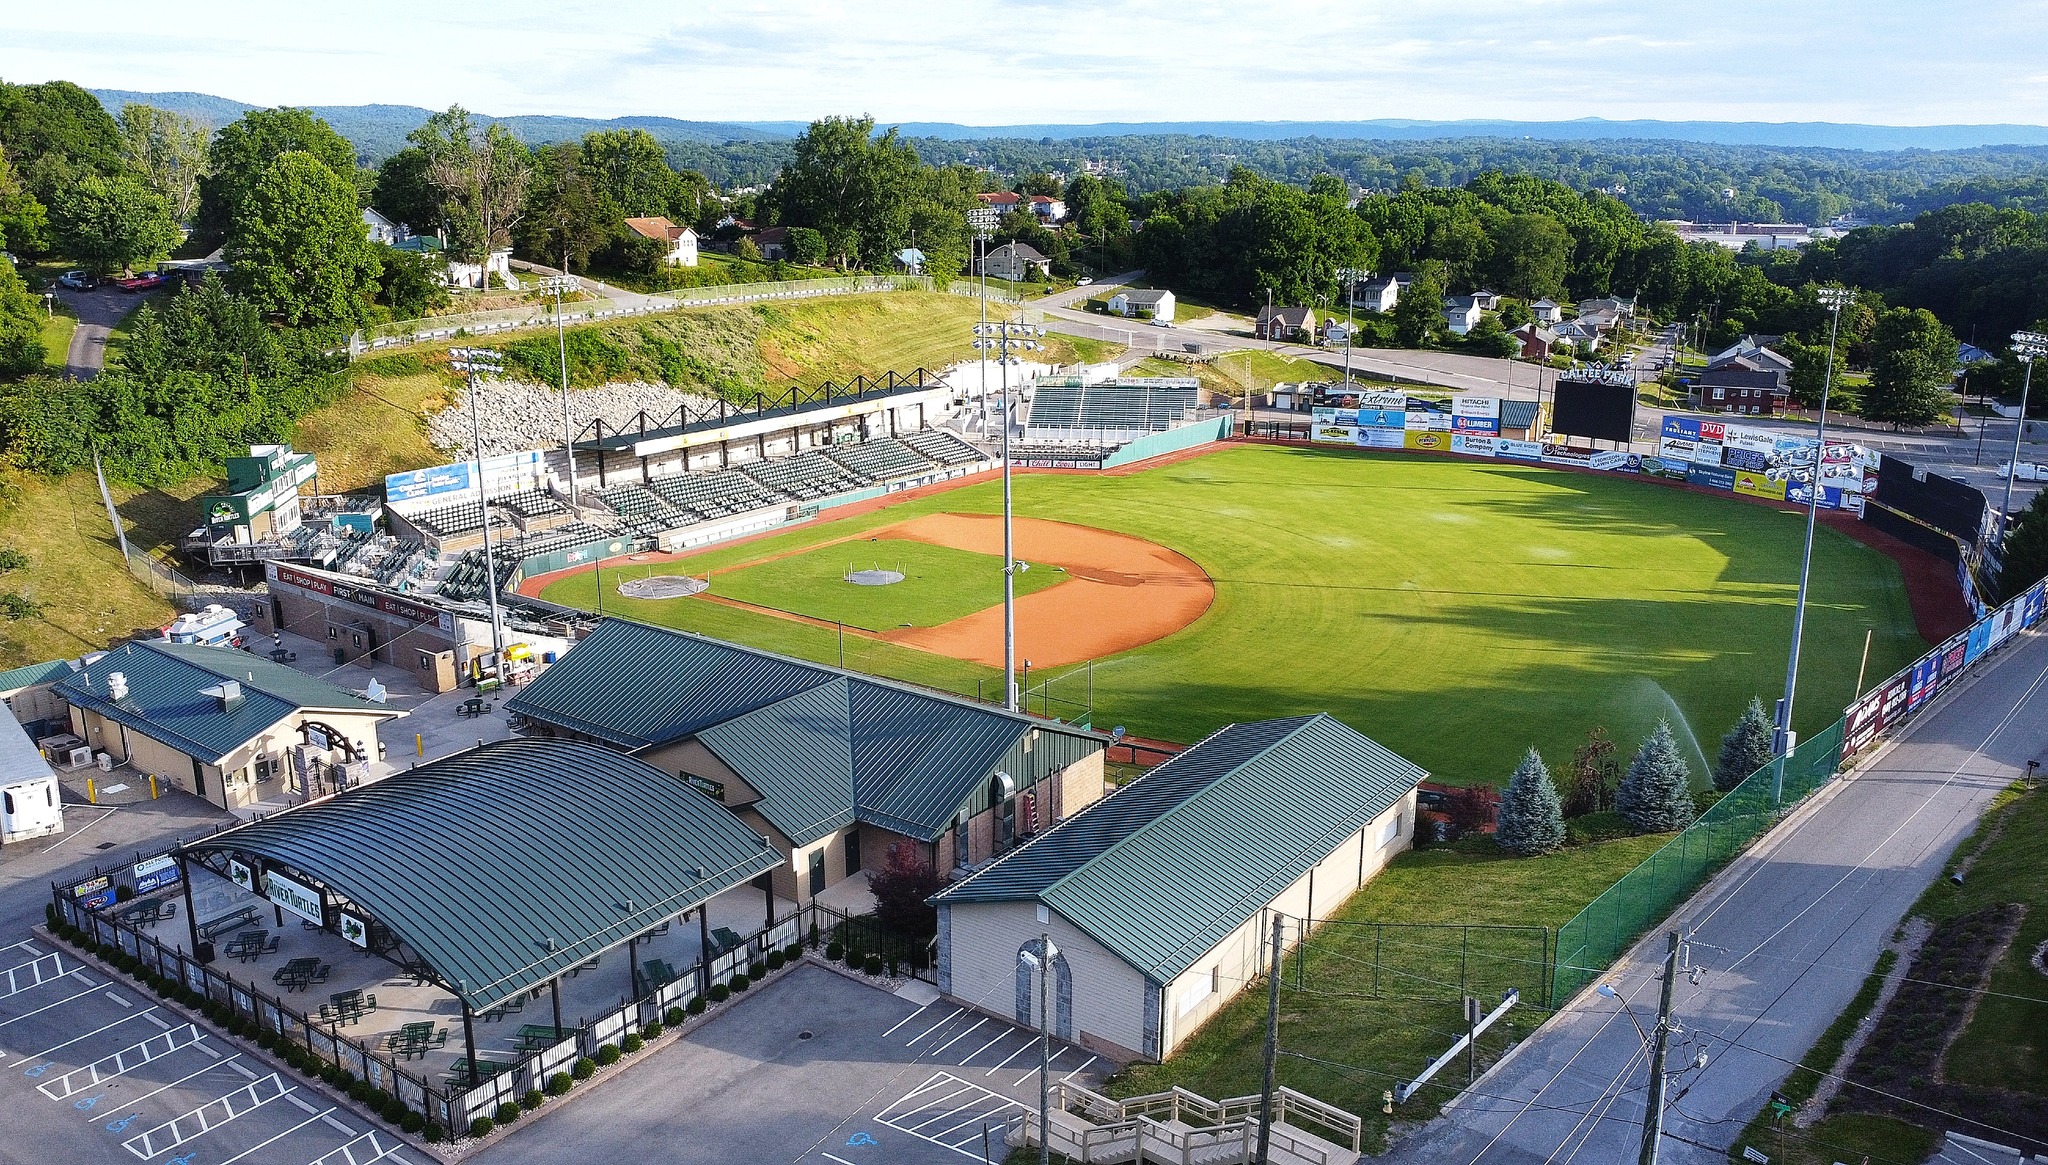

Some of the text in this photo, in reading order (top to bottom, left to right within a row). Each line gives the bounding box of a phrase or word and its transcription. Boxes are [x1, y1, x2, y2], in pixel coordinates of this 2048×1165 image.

[1561, 368, 1634, 387] CALFEE PARK
[1468, 420, 1492, 428] LUMBER
[1701, 423, 1723, 434] DVD
[1465, 436, 1486, 444] Burton
[1740, 432, 1773, 444] LewisGale
[1465, 443, 1493, 452] Company
[1554, 451, 1590, 459] Technologies
[1031, 459, 1049, 467] Chill
[432, 493, 468, 505] GENERAL
[283, 572, 327, 591] EAT SHOP PLAY
[333, 586, 375, 605] FIRST MAIN
[385, 601, 396, 611] EAT
[400, 605, 417, 617] SHOP
[269, 878, 320, 919] RIVER TURTLES
